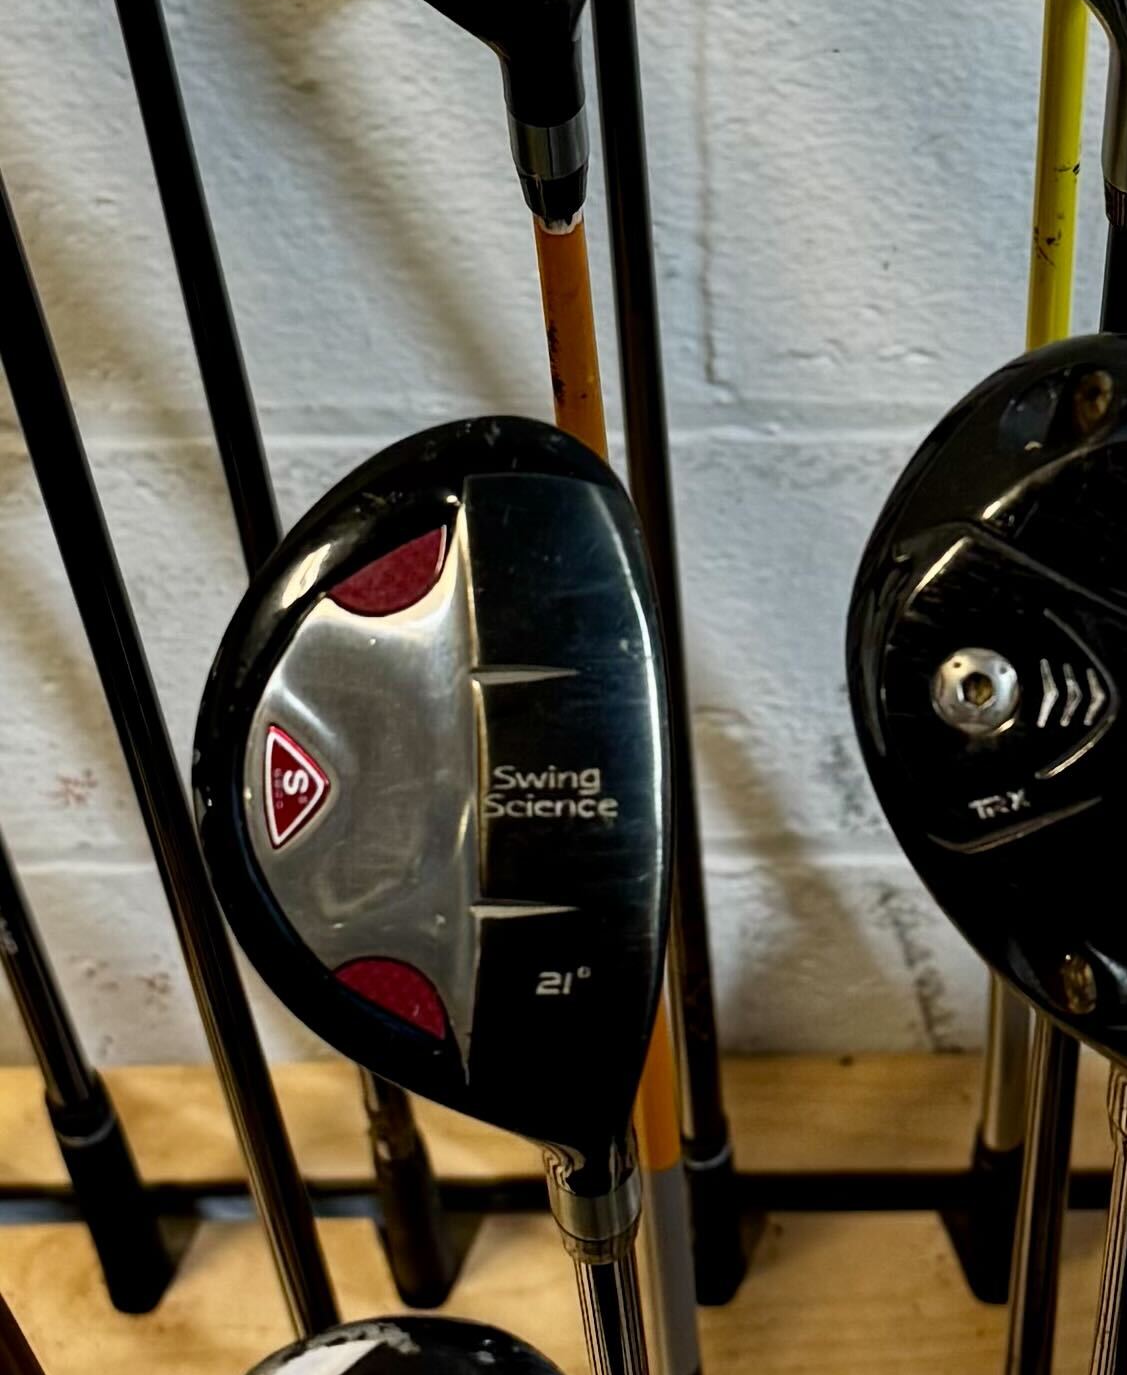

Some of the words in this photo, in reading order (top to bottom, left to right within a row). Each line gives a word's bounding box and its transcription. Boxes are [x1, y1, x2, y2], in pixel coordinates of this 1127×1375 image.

[283, 769, 309, 795] S
[492, 765, 601, 793] Swing
[483, 792, 619, 819] Science
[535, 966, 592, 995] 21°
